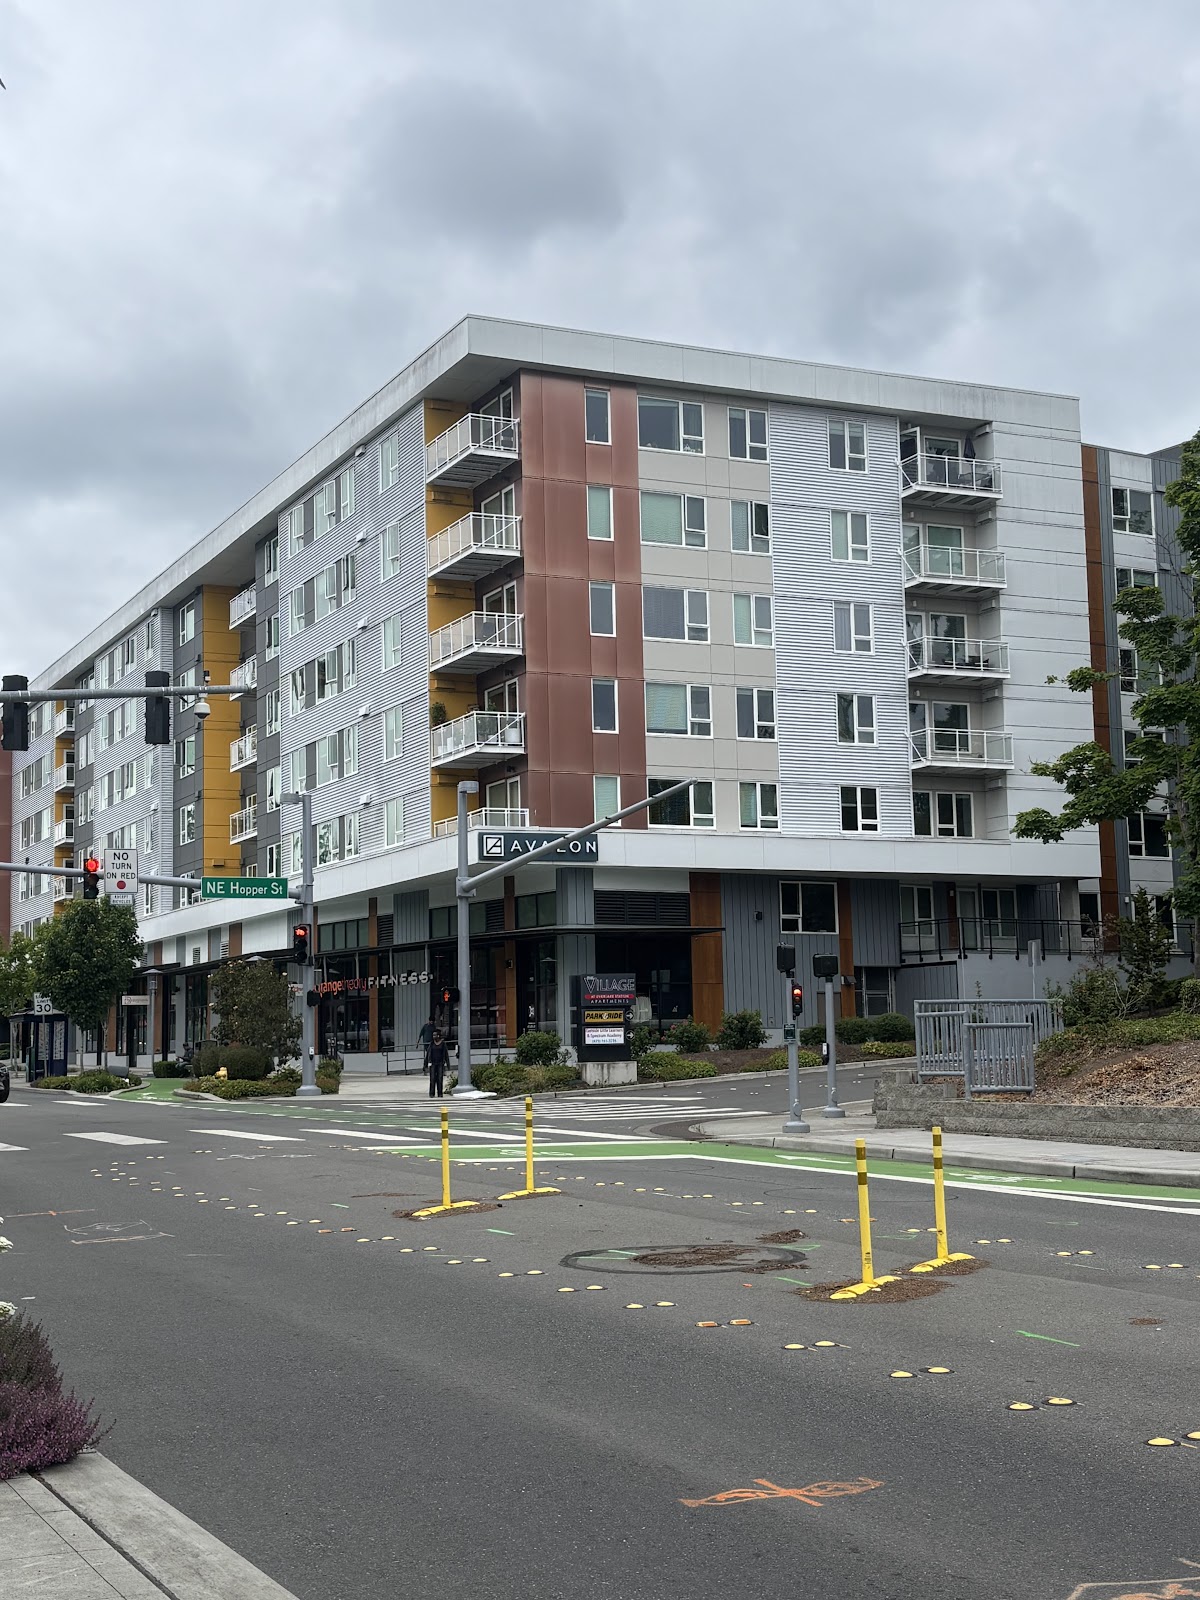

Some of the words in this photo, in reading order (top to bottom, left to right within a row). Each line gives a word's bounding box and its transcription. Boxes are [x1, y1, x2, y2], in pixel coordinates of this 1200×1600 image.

[113, 852, 129, 861] NO
[111, 862, 132, 870] TURN
[106, 872, 117, 880] ON
[120, 872, 136, 880] RED
[206, 881, 226, 894] NE
[230, 881, 268, 896] Hopper
[271, 882, 283, 894] St
[368, 971, 429, 989] FITNESS
[583, 977, 635, 993] VILLAGE
[36, 1004, 51, 1012] 30
